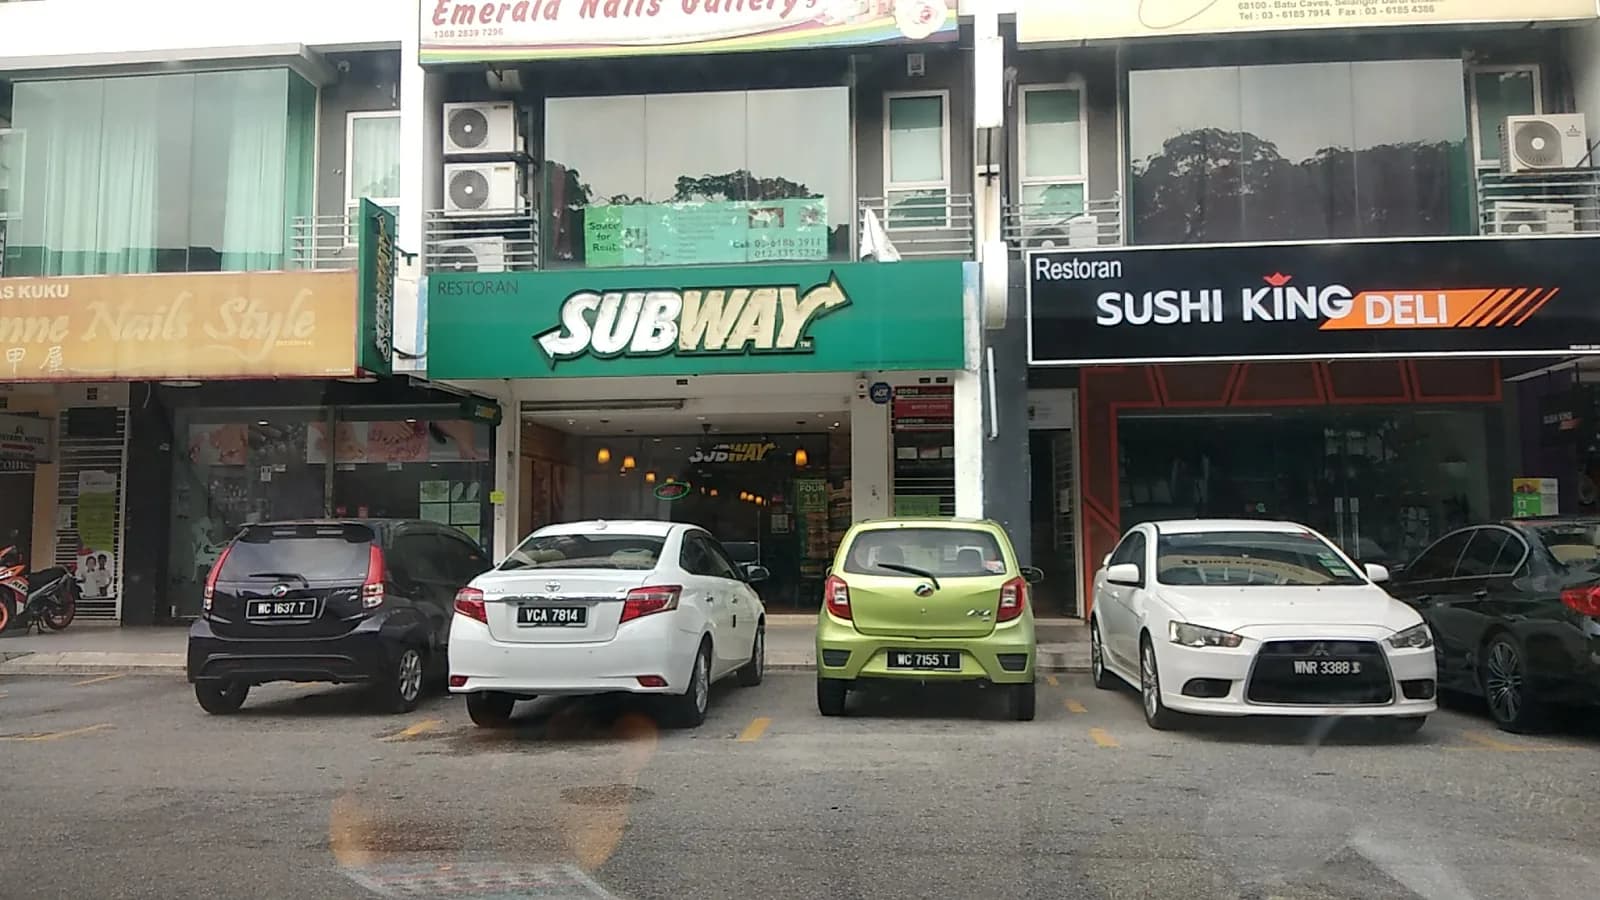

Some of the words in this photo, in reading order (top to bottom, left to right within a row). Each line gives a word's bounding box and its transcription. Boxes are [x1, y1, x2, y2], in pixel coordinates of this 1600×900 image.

[432, 0, 560, 26] Emerald
[580, 0, 661, 18] Nails
[1035, 257, 1122, 281] Restoran
[18, 283, 70, 299] KUKU
[436, 280, 520, 298] RESTORAN
[1096, 289, 1223, 325] SUSHI
[1242, 285, 1353, 321] KING
[1364, 294, 1448, 325] DELI
[81, 290, 194, 342] Nails
[203, 288, 316, 362] Style
[540, 278, 848, 358] SUBWAY
[257, 602, 272, 614] WC
[274, 601, 297, 614] 1637
[299, 601, 306, 613] T
[526, 608, 548, 622] VCA
[551, 607, 578, 622] 7814
[897, 653, 912, 666] WC
[914, 653, 940, 666] 7155
[942, 653, 951, 666] T
[1294, 661, 1318, 674] WNR
[1320, 661, 1350, 674] 3388
